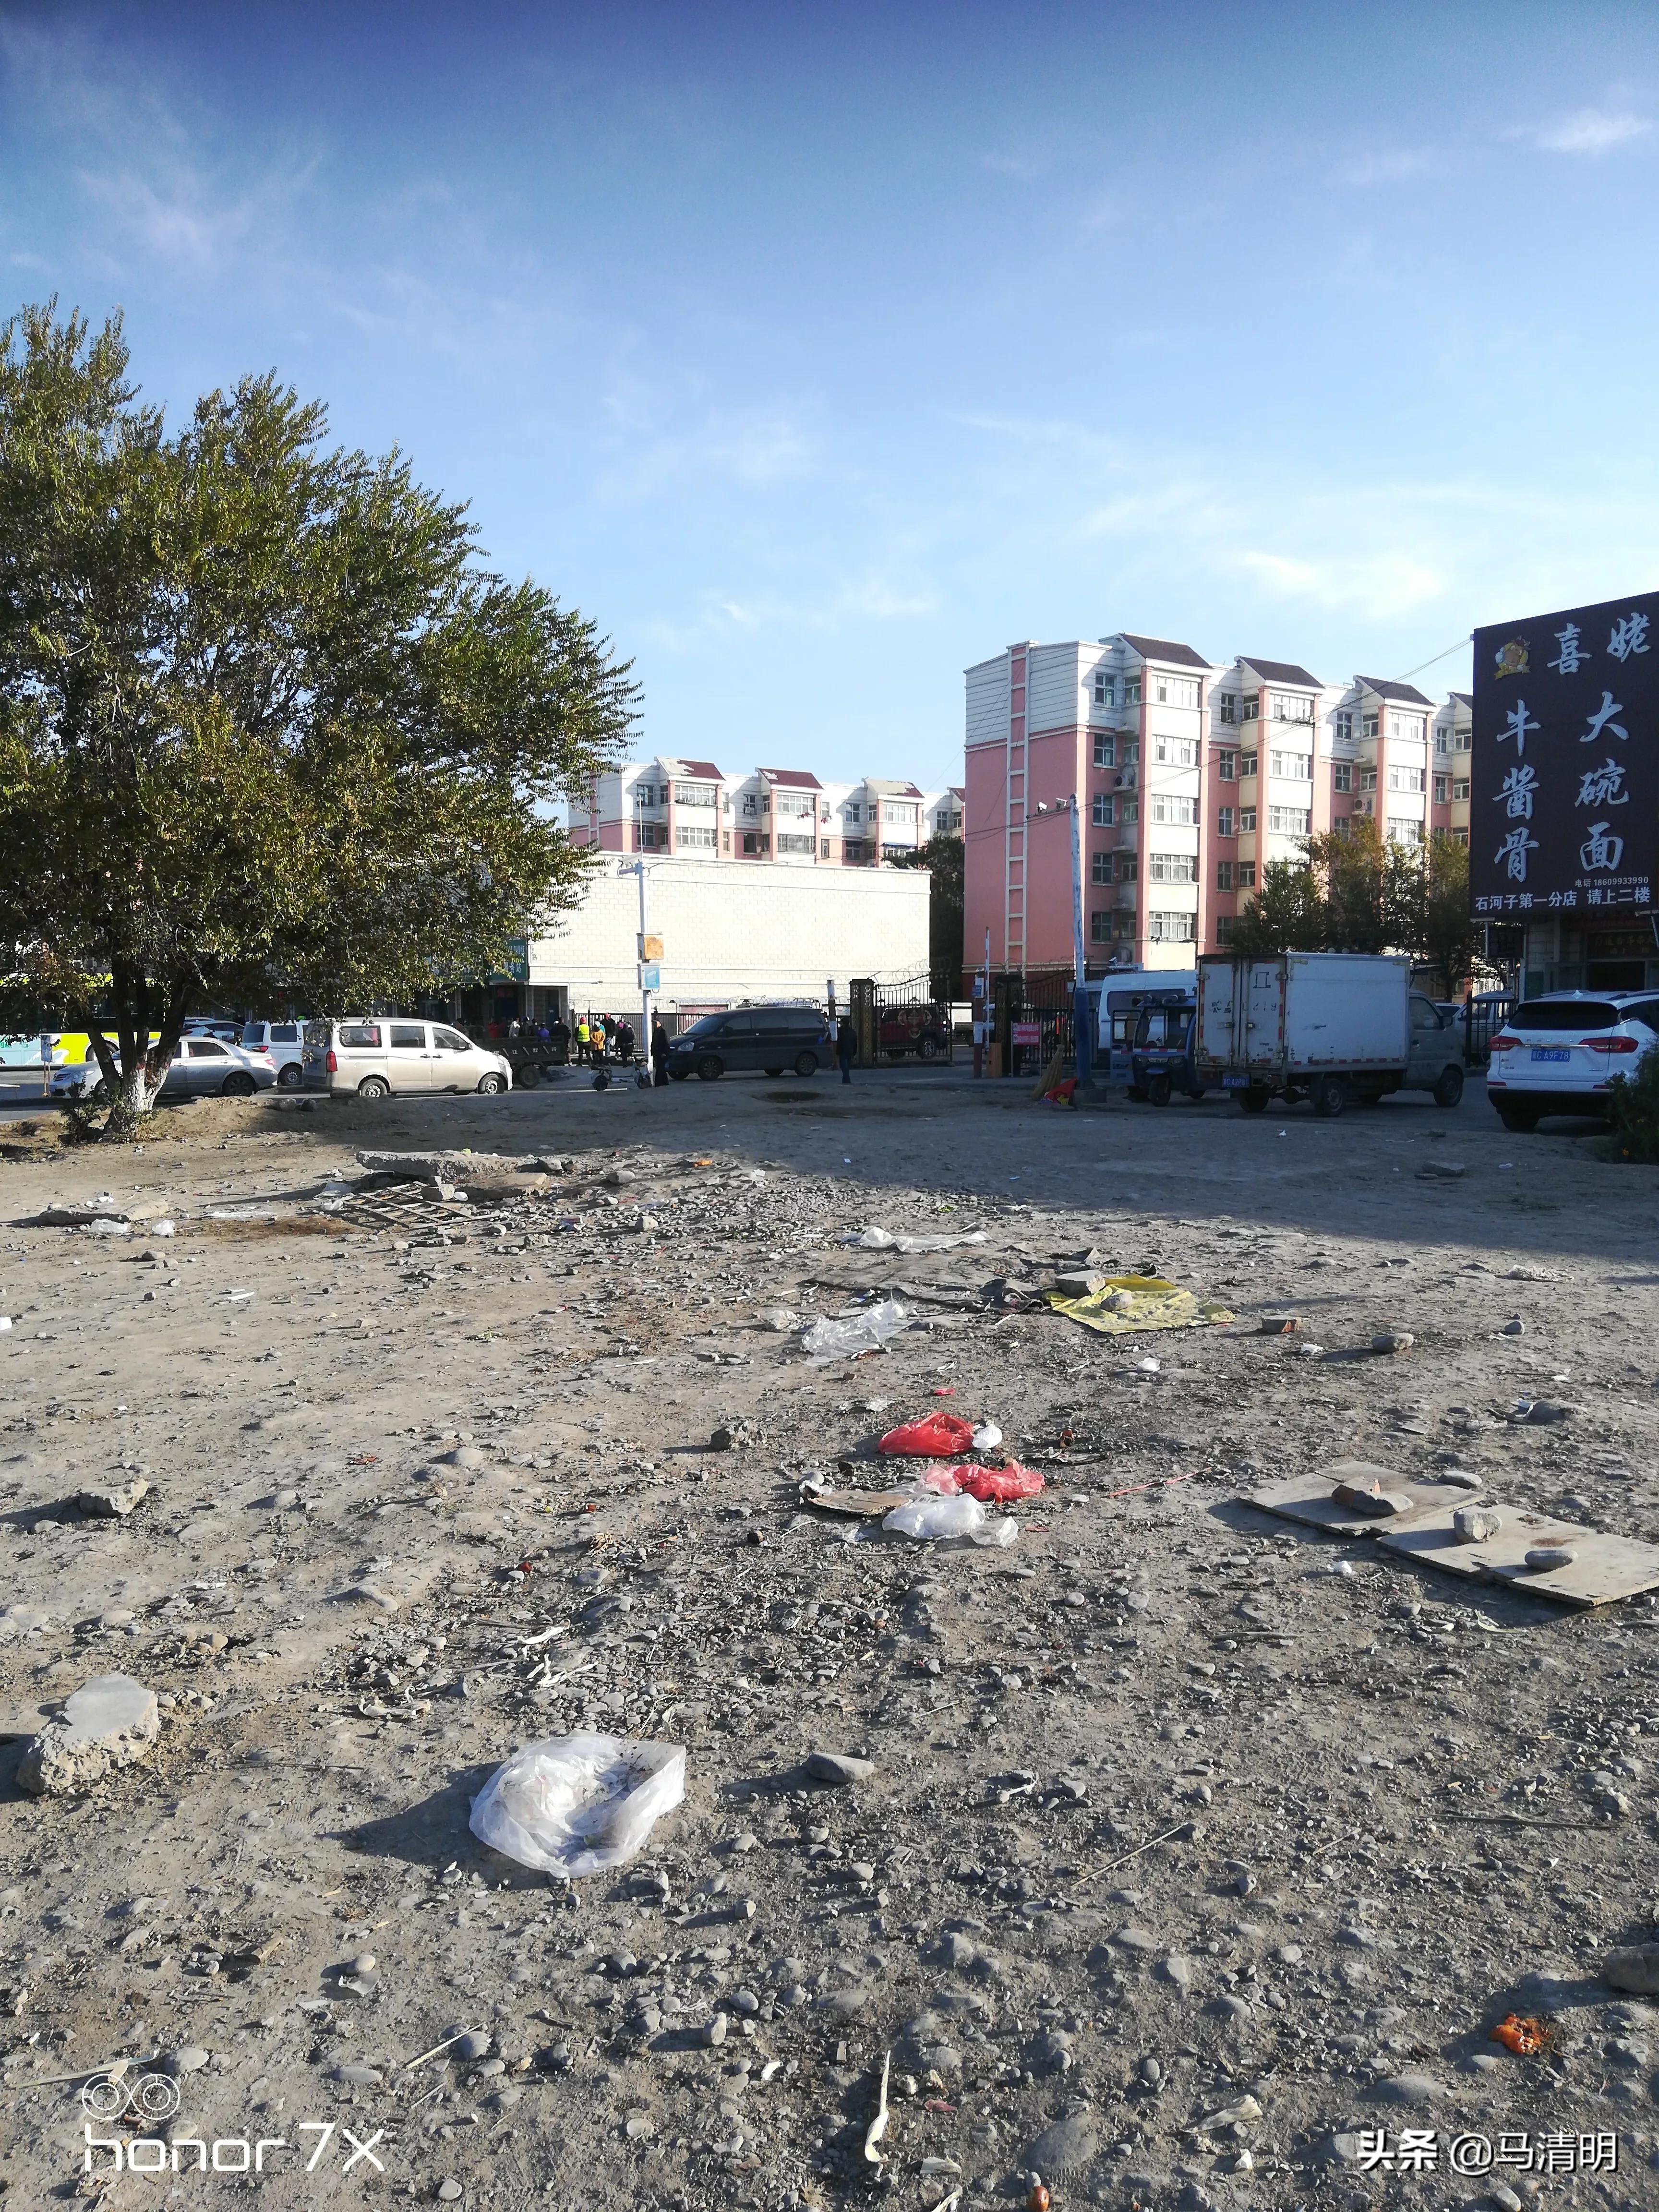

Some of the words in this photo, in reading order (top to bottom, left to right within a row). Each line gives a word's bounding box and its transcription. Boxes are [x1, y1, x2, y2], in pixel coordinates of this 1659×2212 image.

[1575, 878, 1591, 888] 电话
[1594, 877, 1649, 886] 18609933990
[1475, 890, 1578, 911] 石河子第一分店
[1587, 886, 1651, 905] 请上二楼
